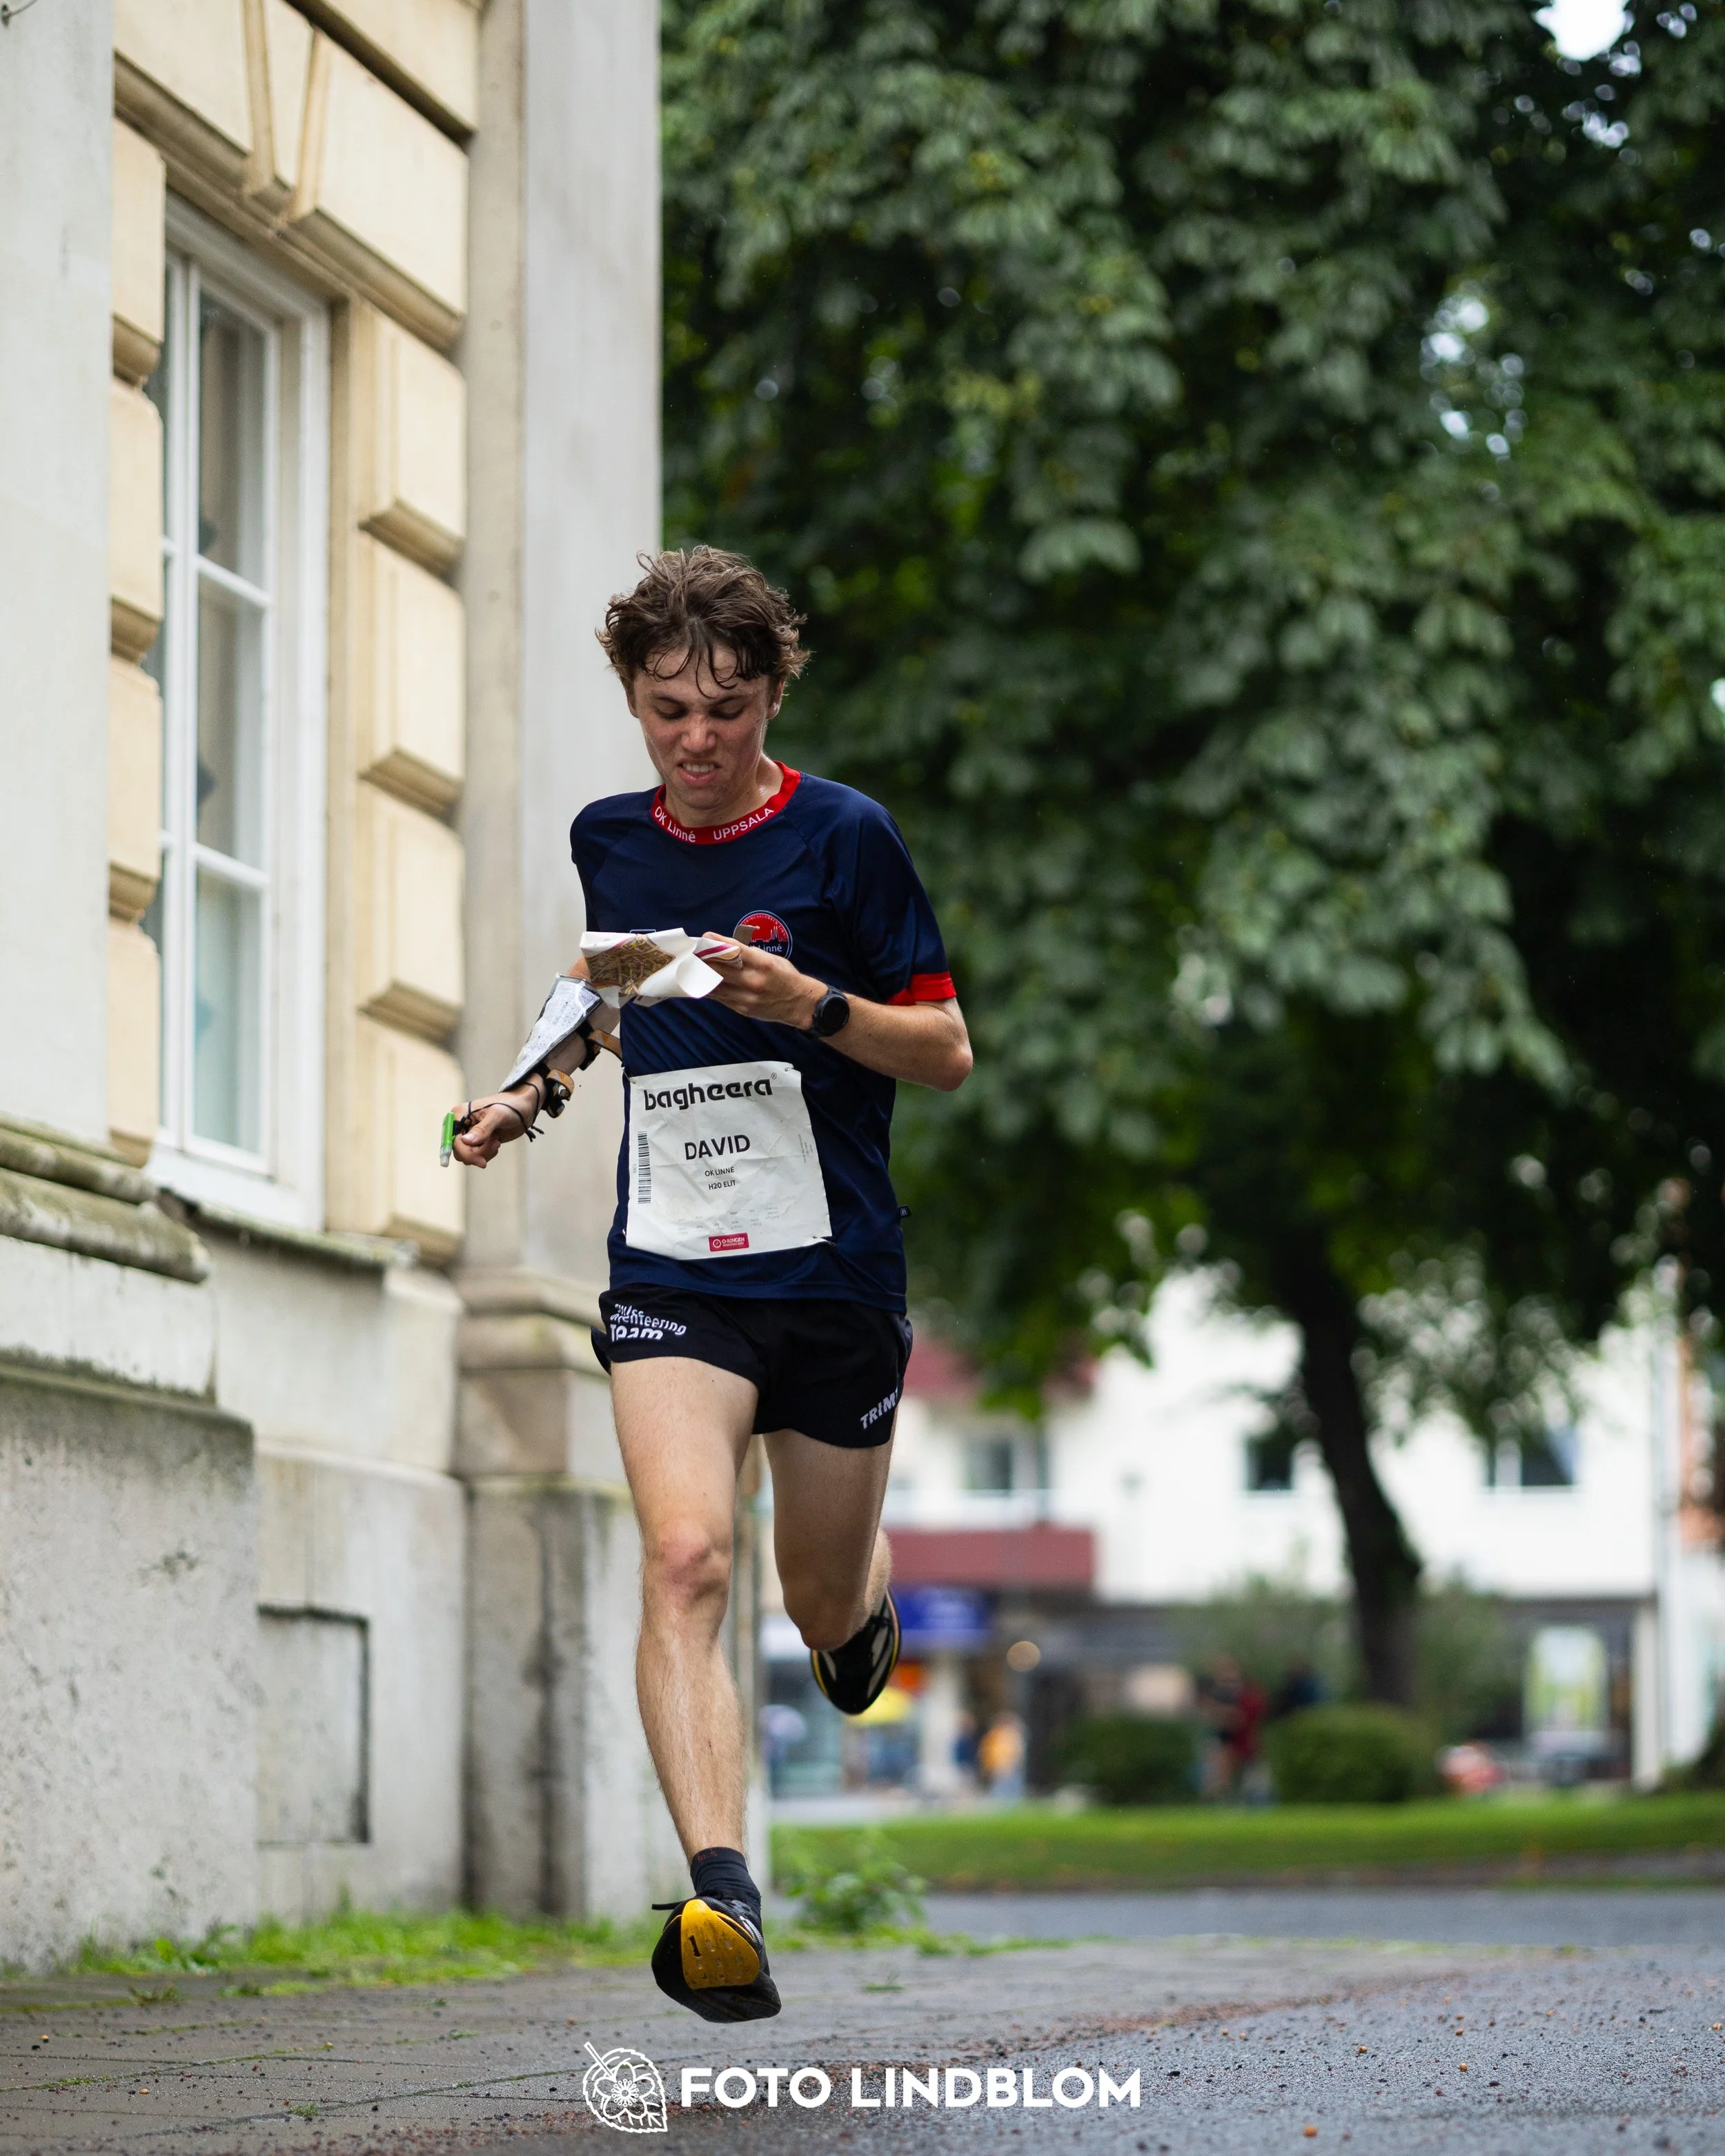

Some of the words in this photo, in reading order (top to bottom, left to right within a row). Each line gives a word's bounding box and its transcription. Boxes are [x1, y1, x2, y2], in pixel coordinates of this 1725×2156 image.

[654, 806, 665, 826] OK
[667, 820, 696, 842] Linné
[713, 808, 774, 840] UPPSALA
[684, 1134, 751, 1160] DAVID
[715, 1165, 735, 1176] LINNÉ
[709, 1182, 722, 1190] H20
